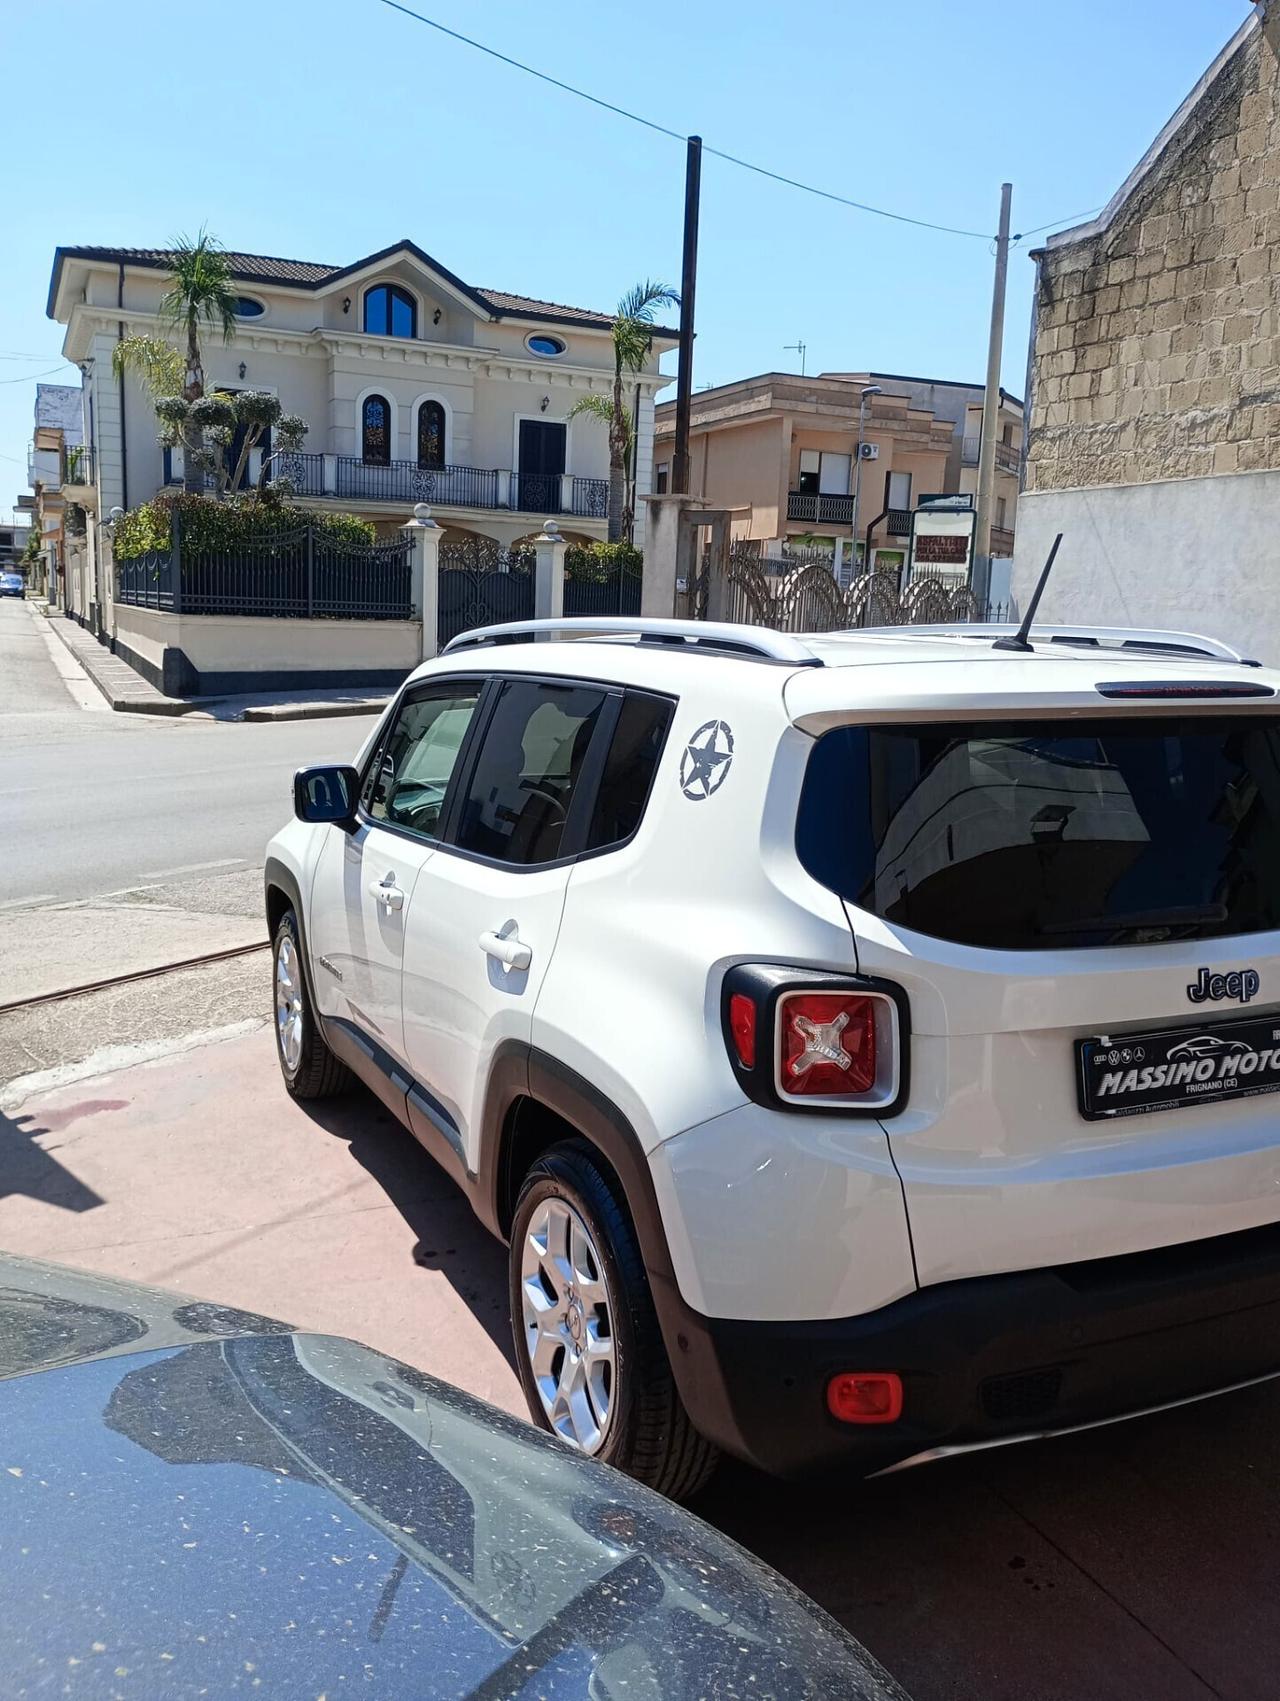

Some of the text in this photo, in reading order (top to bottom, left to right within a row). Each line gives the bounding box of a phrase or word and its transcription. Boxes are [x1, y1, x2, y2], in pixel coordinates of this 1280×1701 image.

[1187, 968, 1259, 1002] Jeep
[1097, 1059, 1215, 1096] MASSIMO
[1186, 1080, 1222, 1094] FRIGNANO
[1223, 1077, 1238, 1091] (CE)
